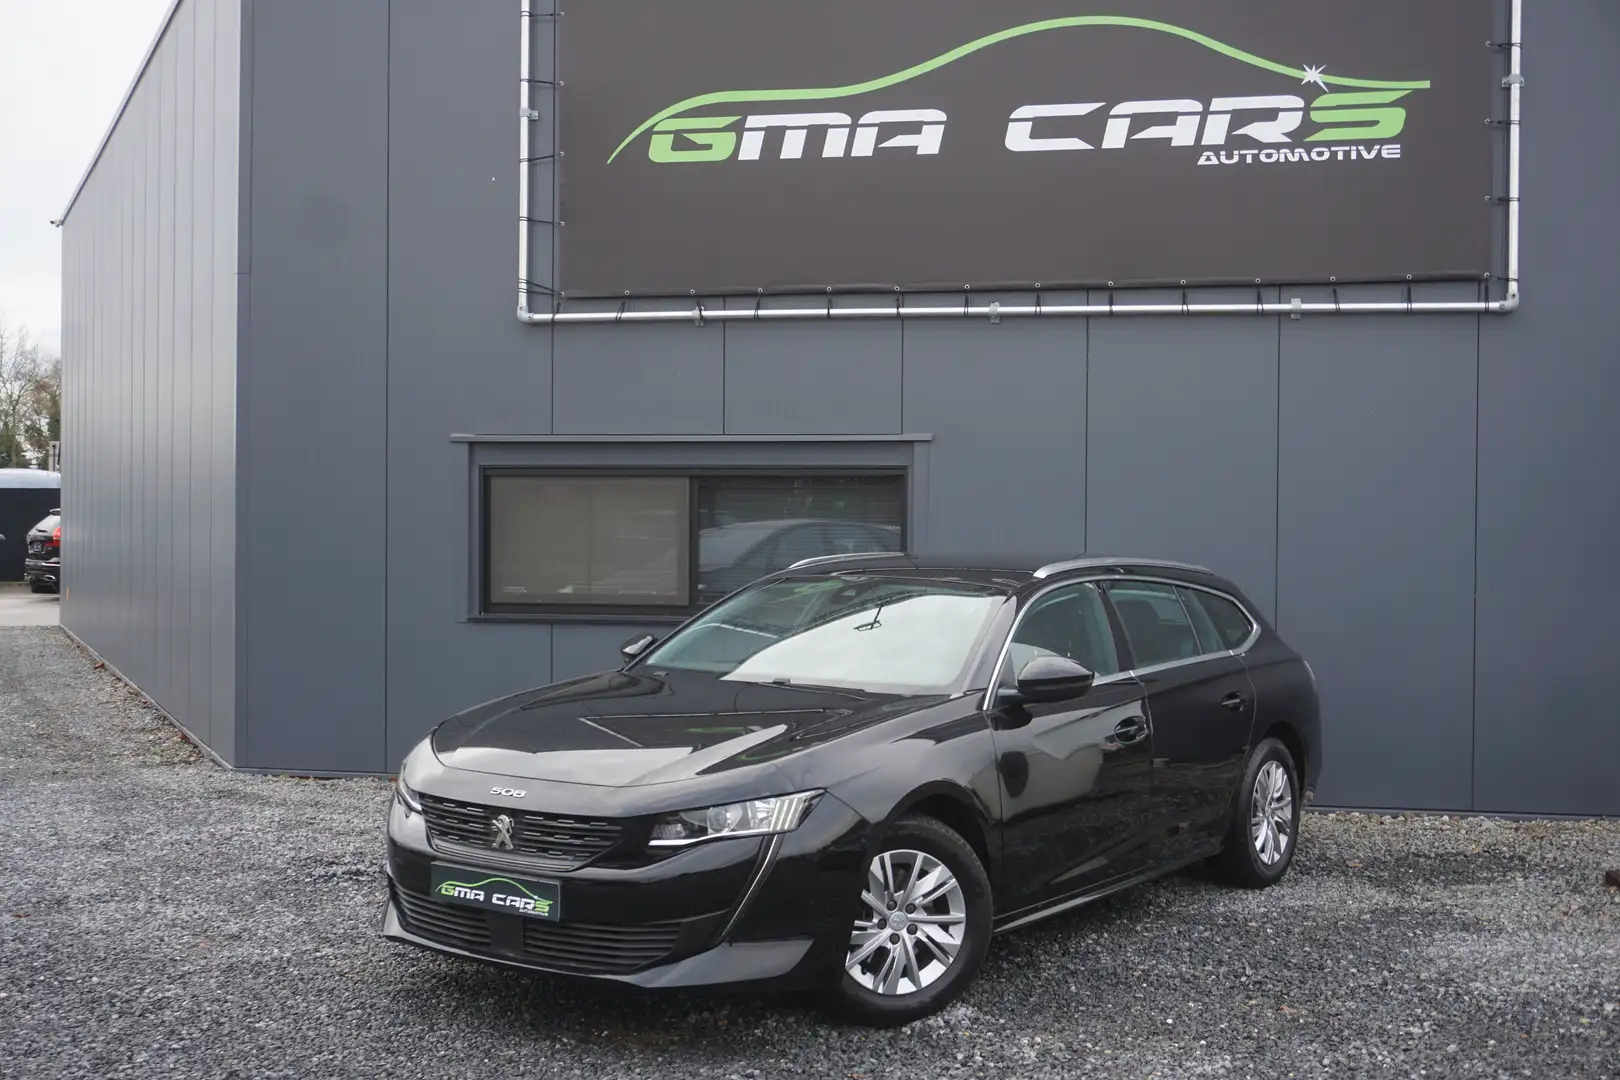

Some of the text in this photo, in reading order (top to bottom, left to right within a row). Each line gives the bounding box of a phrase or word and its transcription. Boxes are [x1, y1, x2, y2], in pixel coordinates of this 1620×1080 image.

[649, 90, 1414, 163] GMA CARS
[1197, 144, 1401, 165] AUTOMOTIVE
[490, 787, 527, 798] 508
[441, 885, 551, 912] GMA CARS
